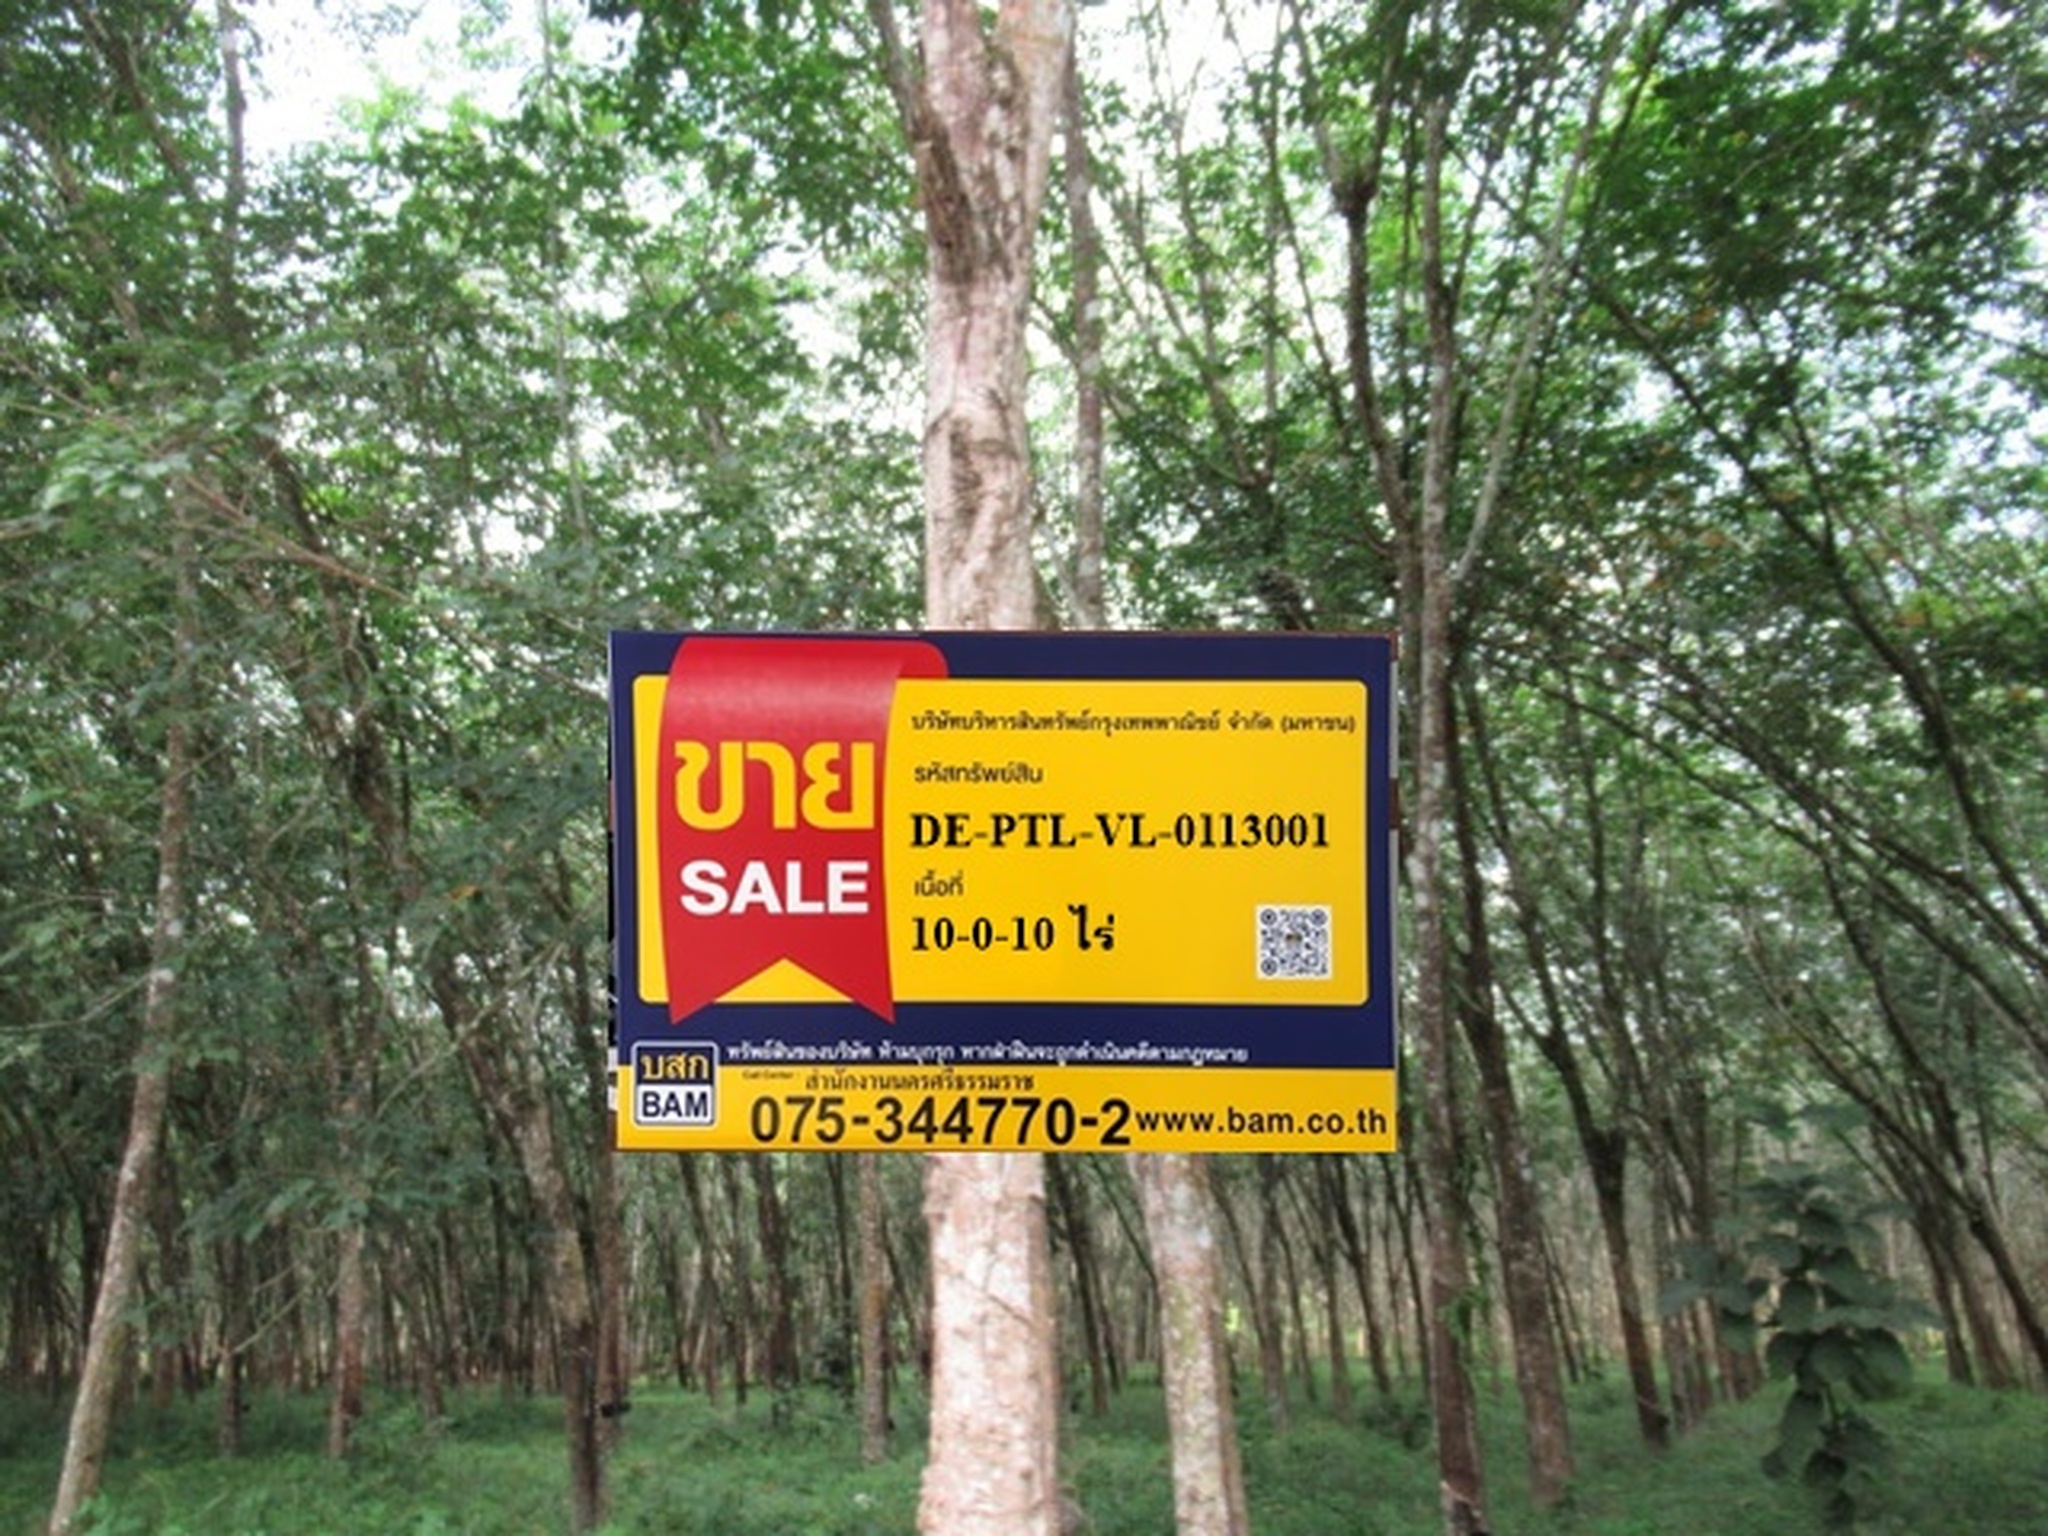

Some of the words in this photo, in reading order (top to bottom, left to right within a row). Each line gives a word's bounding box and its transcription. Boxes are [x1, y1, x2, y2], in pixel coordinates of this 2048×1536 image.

[911, 708, 1220, 737] บริษัทบริหารสินทรัพย์กรุงเทพพาณิชย์
[1229, 710, 1273, 732] จำกัด
[1281, 714, 1356, 734] (มหาชน)
[674, 740, 875, 830] ขาย
[914, 762, 1044, 784] รหัสทรัพย์สิน
[909, 812, 1330, 849] DE-PTL-VL-0113001
[680, 859, 869, 916] SALE
[914, 870, 964, 897] เนื้อที่
[911, 916, 1055, 951] 10-0-10
[1068, 904, 1116, 951] ไร่
[640, 1053, 709, 1080] บสก
[806, 1068, 1035, 1091] สำนักงานนครศรีธรรมราช
[642, 1091, 708, 1118] BAM
[751, 1095, 1132, 1146] 075-344770-2
[1136, 1108, 1388, 1135] www.bam.co.th
